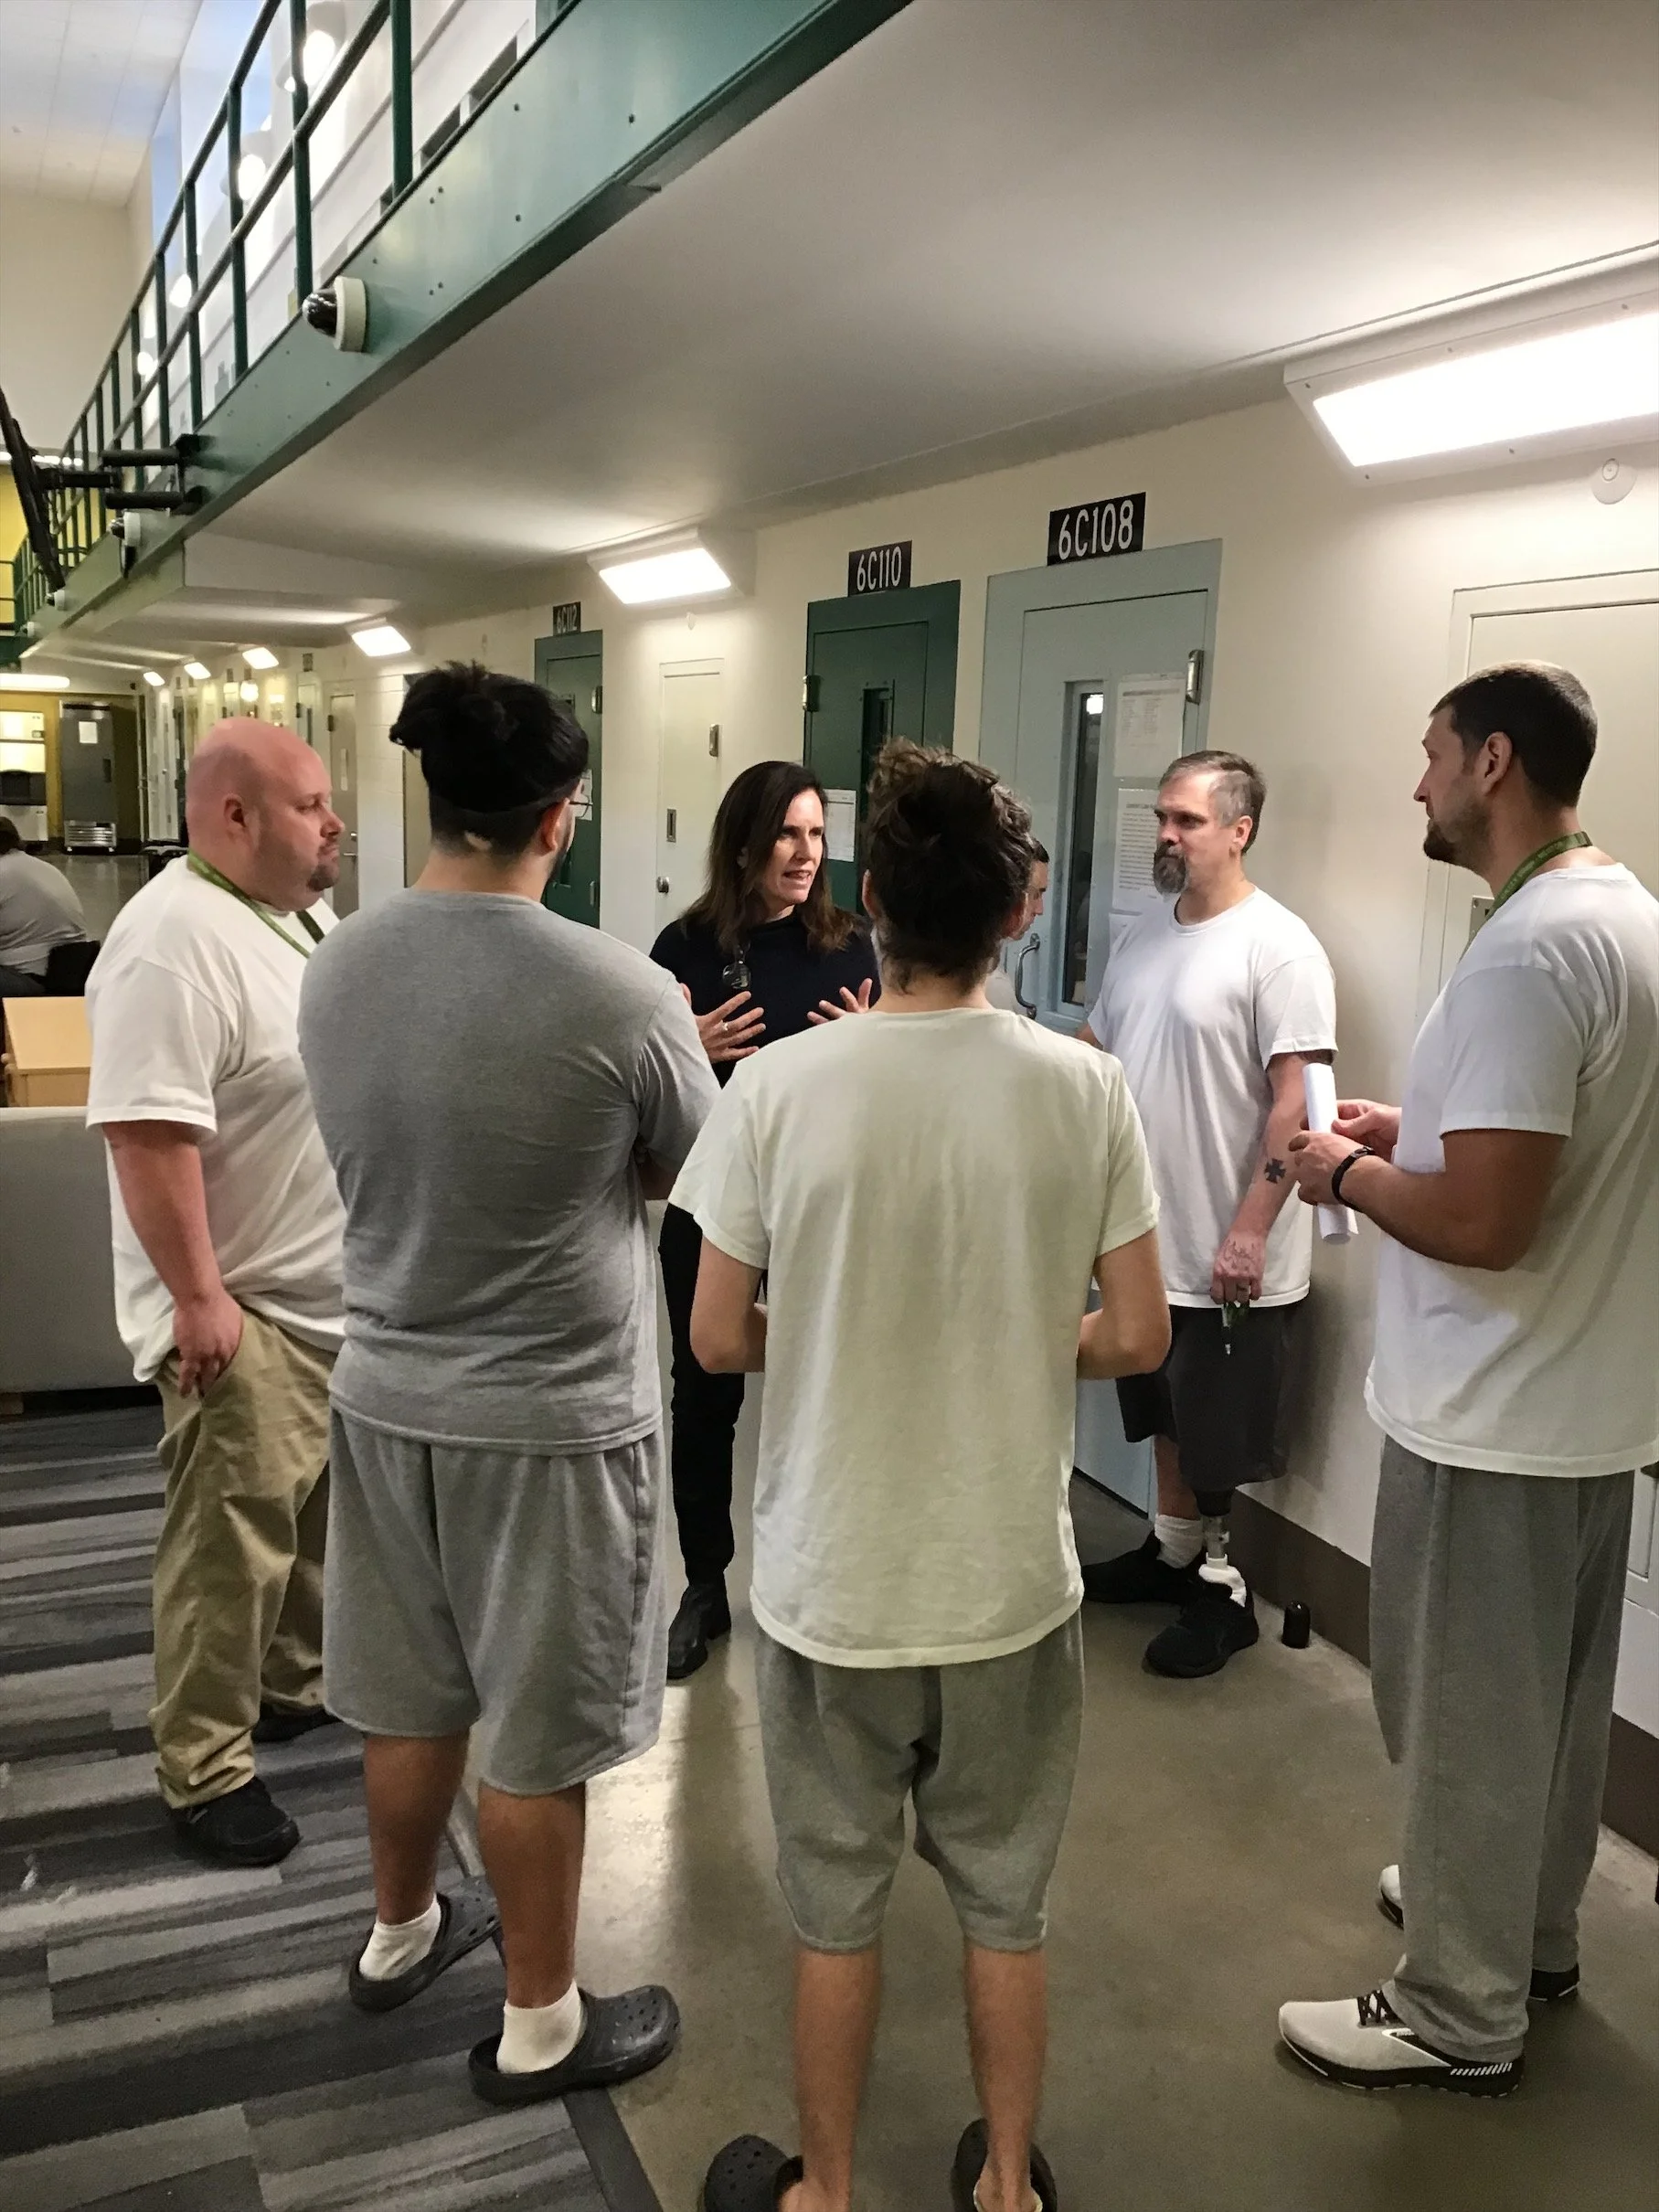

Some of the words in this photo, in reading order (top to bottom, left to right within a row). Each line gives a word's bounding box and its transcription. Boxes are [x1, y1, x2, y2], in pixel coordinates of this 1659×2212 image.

[1058, 499, 1134, 560] 6C108
[856, 545, 902, 592] 6C110
[556, 604, 578, 633] 6C112
